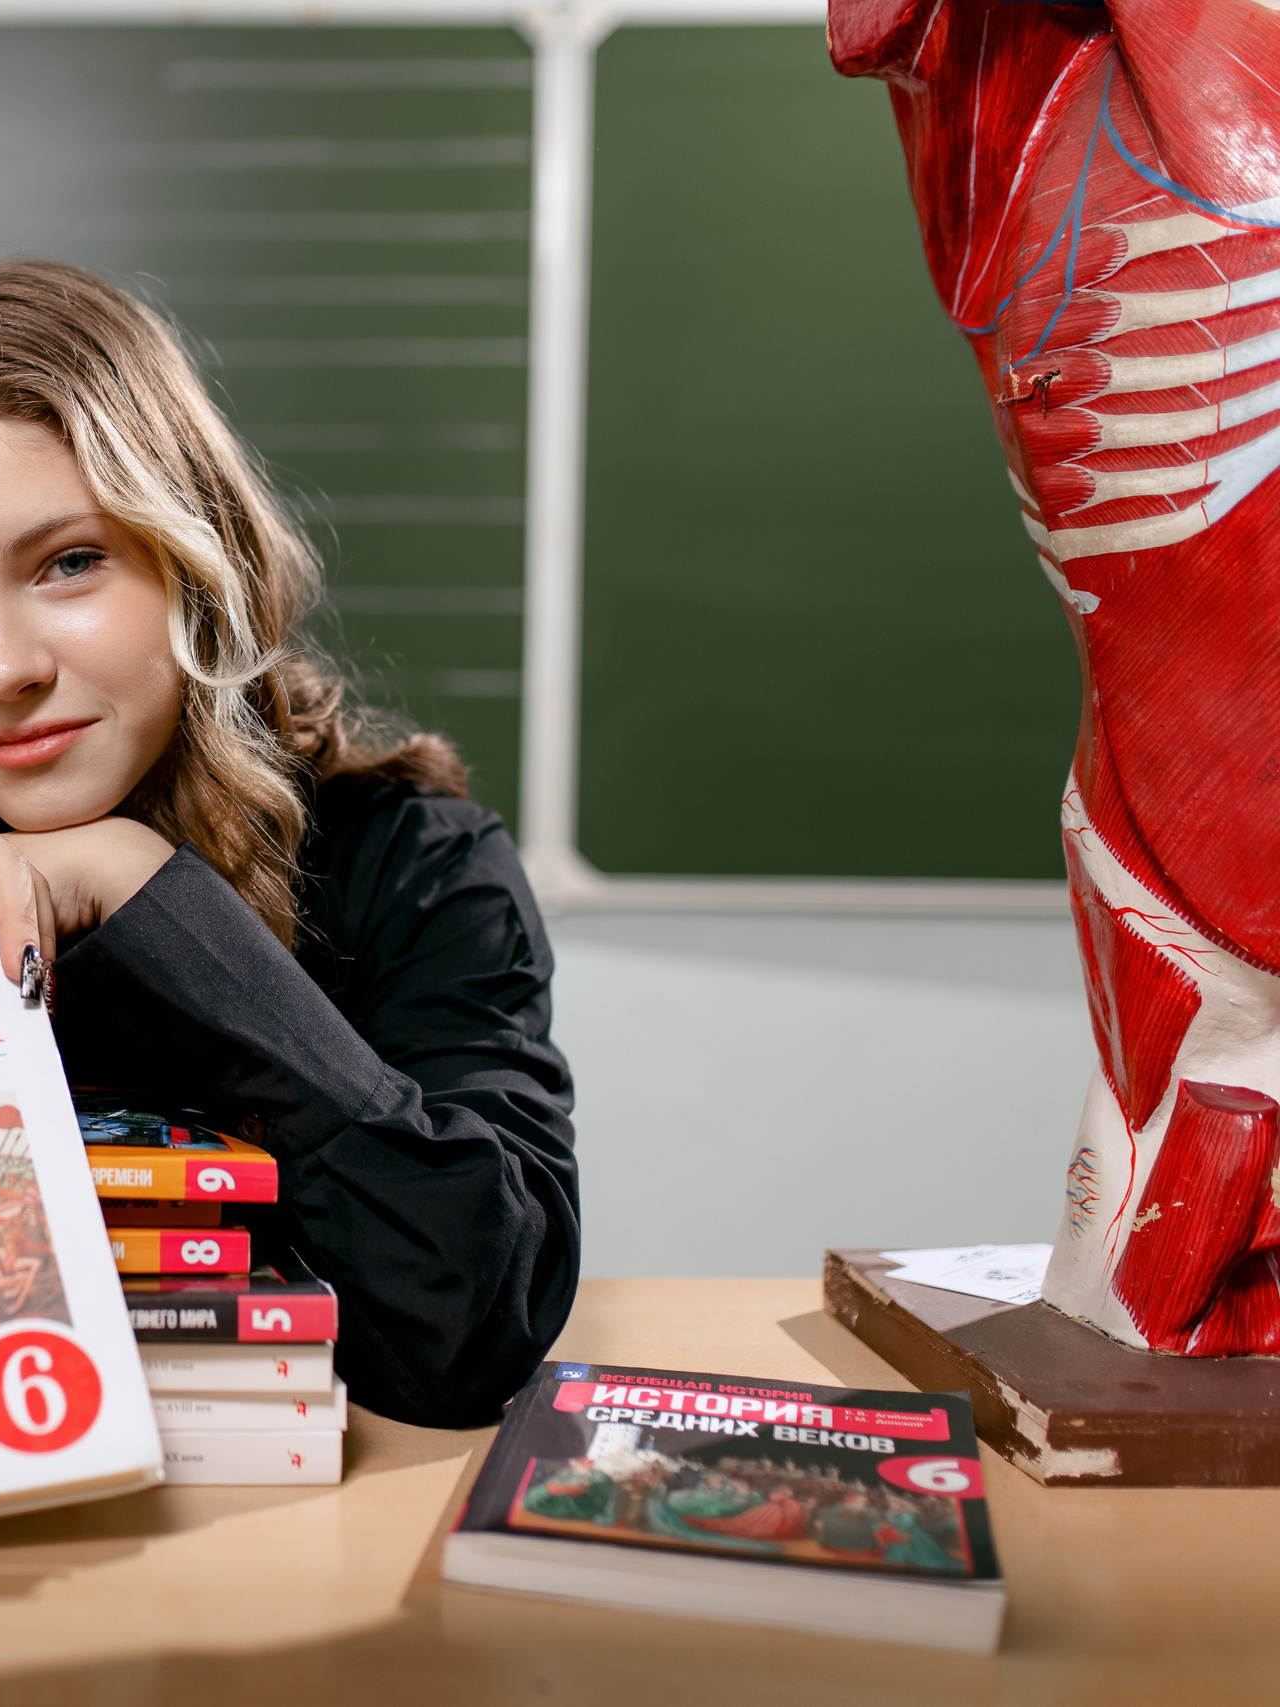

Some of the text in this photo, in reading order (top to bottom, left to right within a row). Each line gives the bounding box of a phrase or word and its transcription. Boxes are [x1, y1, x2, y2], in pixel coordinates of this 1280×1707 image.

[197, 1167, 236, 1193] 9
[181, 1239, 221, 1265] 8
[129, 1309, 218, 1330] ЕВНЕГО МИРА
[252, 1308, 292, 1333] 5
[0, 1345, 68, 1436] 6
[599, 1373, 813, 1402] ВСЕОБЩАЯ ИСТОРИЯ
[591, 1385, 834, 1428] ИСТОРИЯ
[586, 1405, 897, 1454] СРЕДНИХ ВЕКОВ
[907, 1461, 971, 1493] 6
